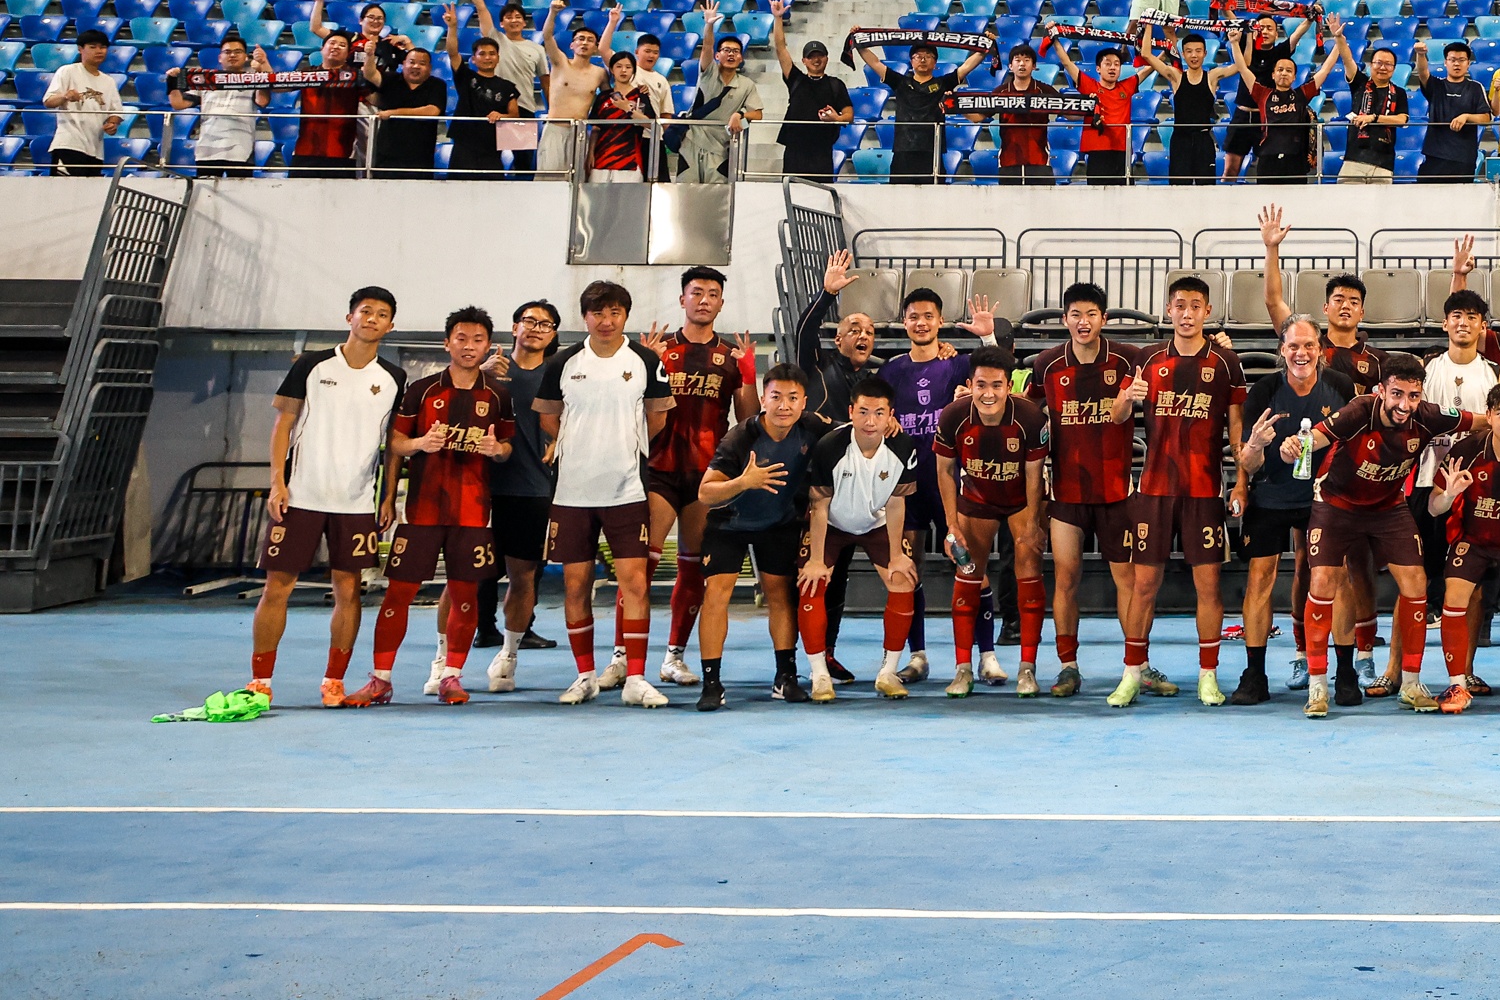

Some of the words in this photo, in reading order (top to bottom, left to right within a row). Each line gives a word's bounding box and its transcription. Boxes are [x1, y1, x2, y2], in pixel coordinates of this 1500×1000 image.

[957, 96, 1027, 109] 吾心向陕
[670, 370, 724, 390] 速力奥
[691, 387, 720, 399] AURA
[1155, 388, 1213, 411] 速力奥
[1060, 415, 1086, 425] SULI
[1154, 408, 1179, 418] SULI
[1179, 409, 1209, 420] AURA
[967, 458, 1020, 475] 速力奥
[1358, 457, 1414, 476] 速力奥
[967, 471, 990, 480] SULI
[990, 472, 1020, 482] AURA
[1355, 470, 1382, 482] SULI
[1473, 510, 1500, 520] SULI
[352, 531, 378, 558] 20
[1202, 526, 1224, 549] 33
[473, 542, 495, 569] 35
